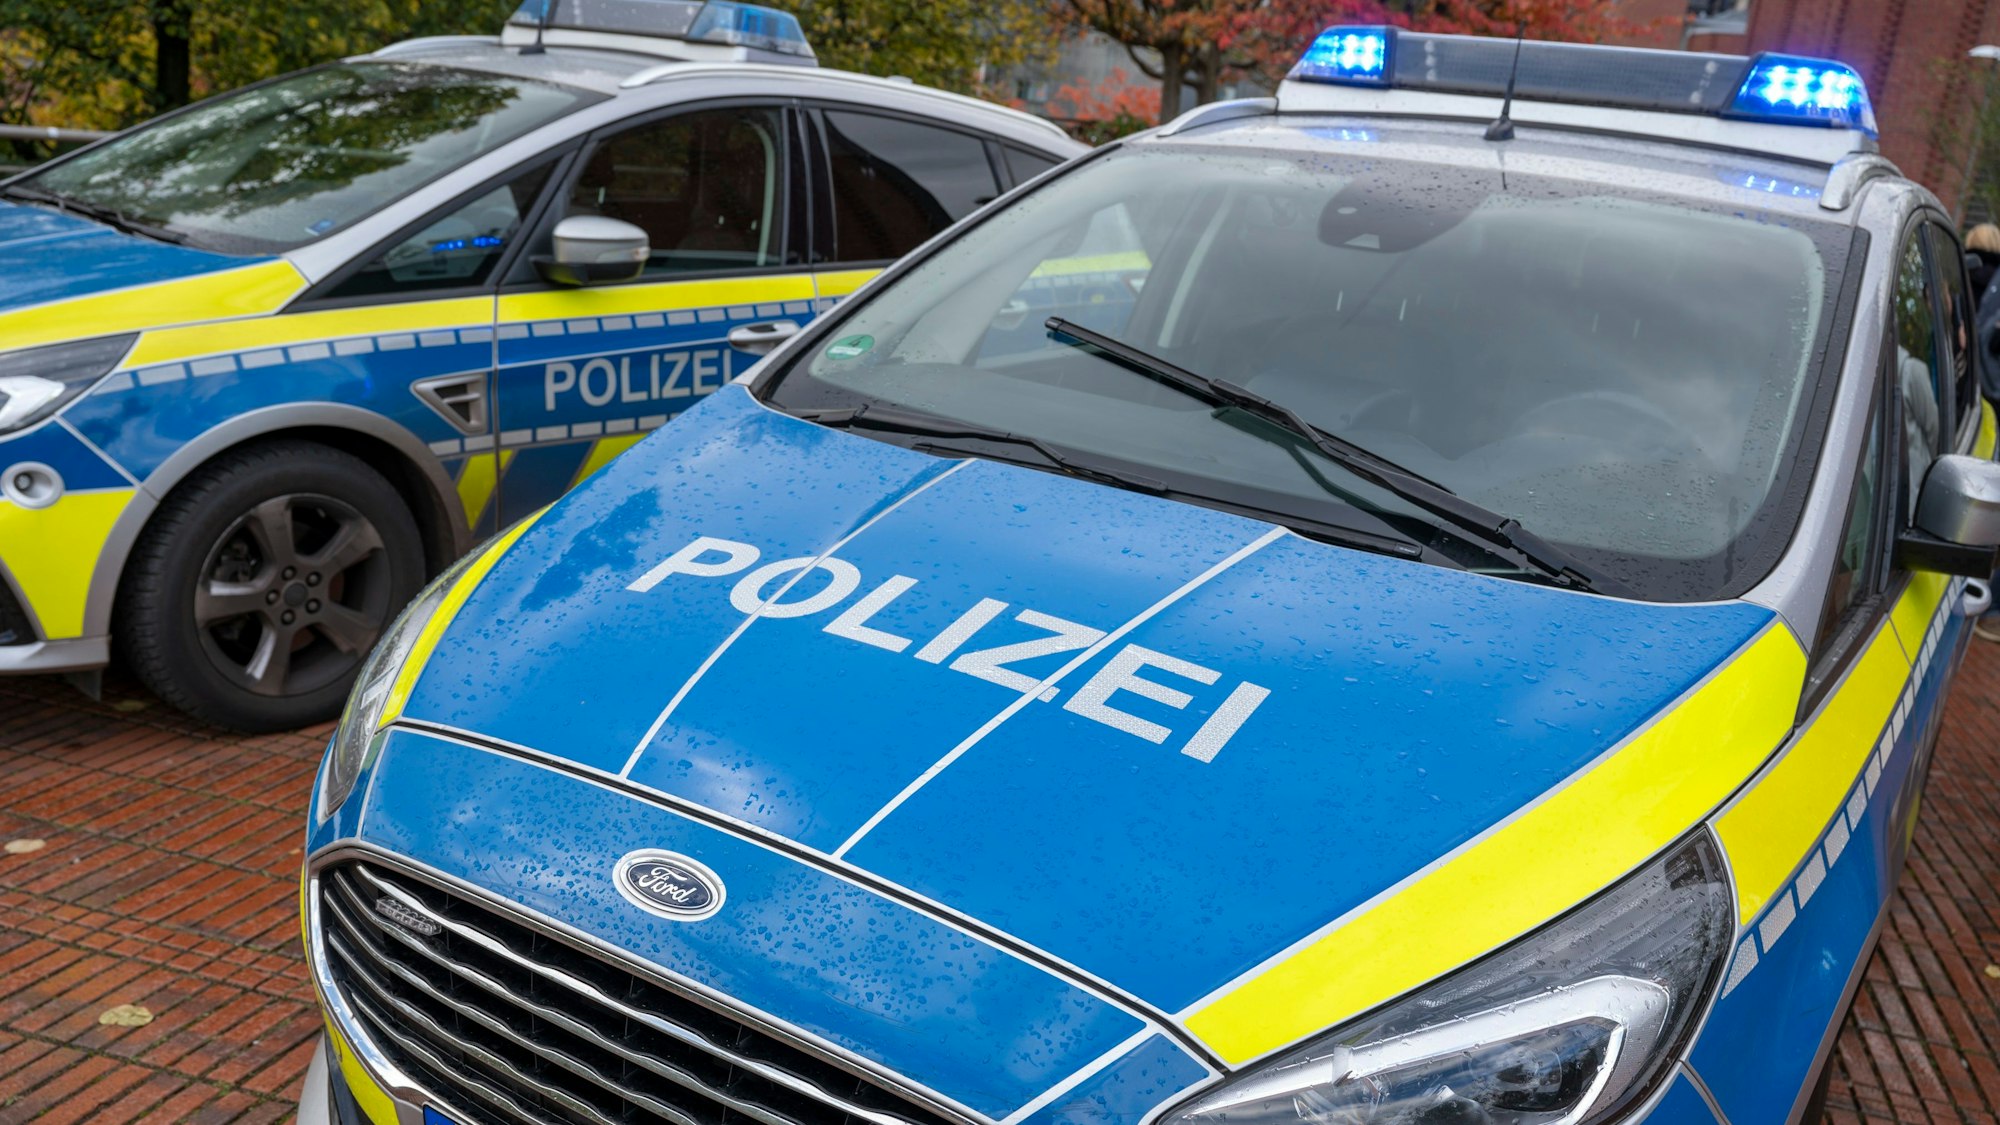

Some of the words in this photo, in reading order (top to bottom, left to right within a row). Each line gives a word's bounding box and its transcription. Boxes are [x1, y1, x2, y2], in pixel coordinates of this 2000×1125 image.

[545, 349, 732, 411] POLIZEI
[625, 536, 1271, 763] POLIZEI
[639, 867, 697, 903] Ford
